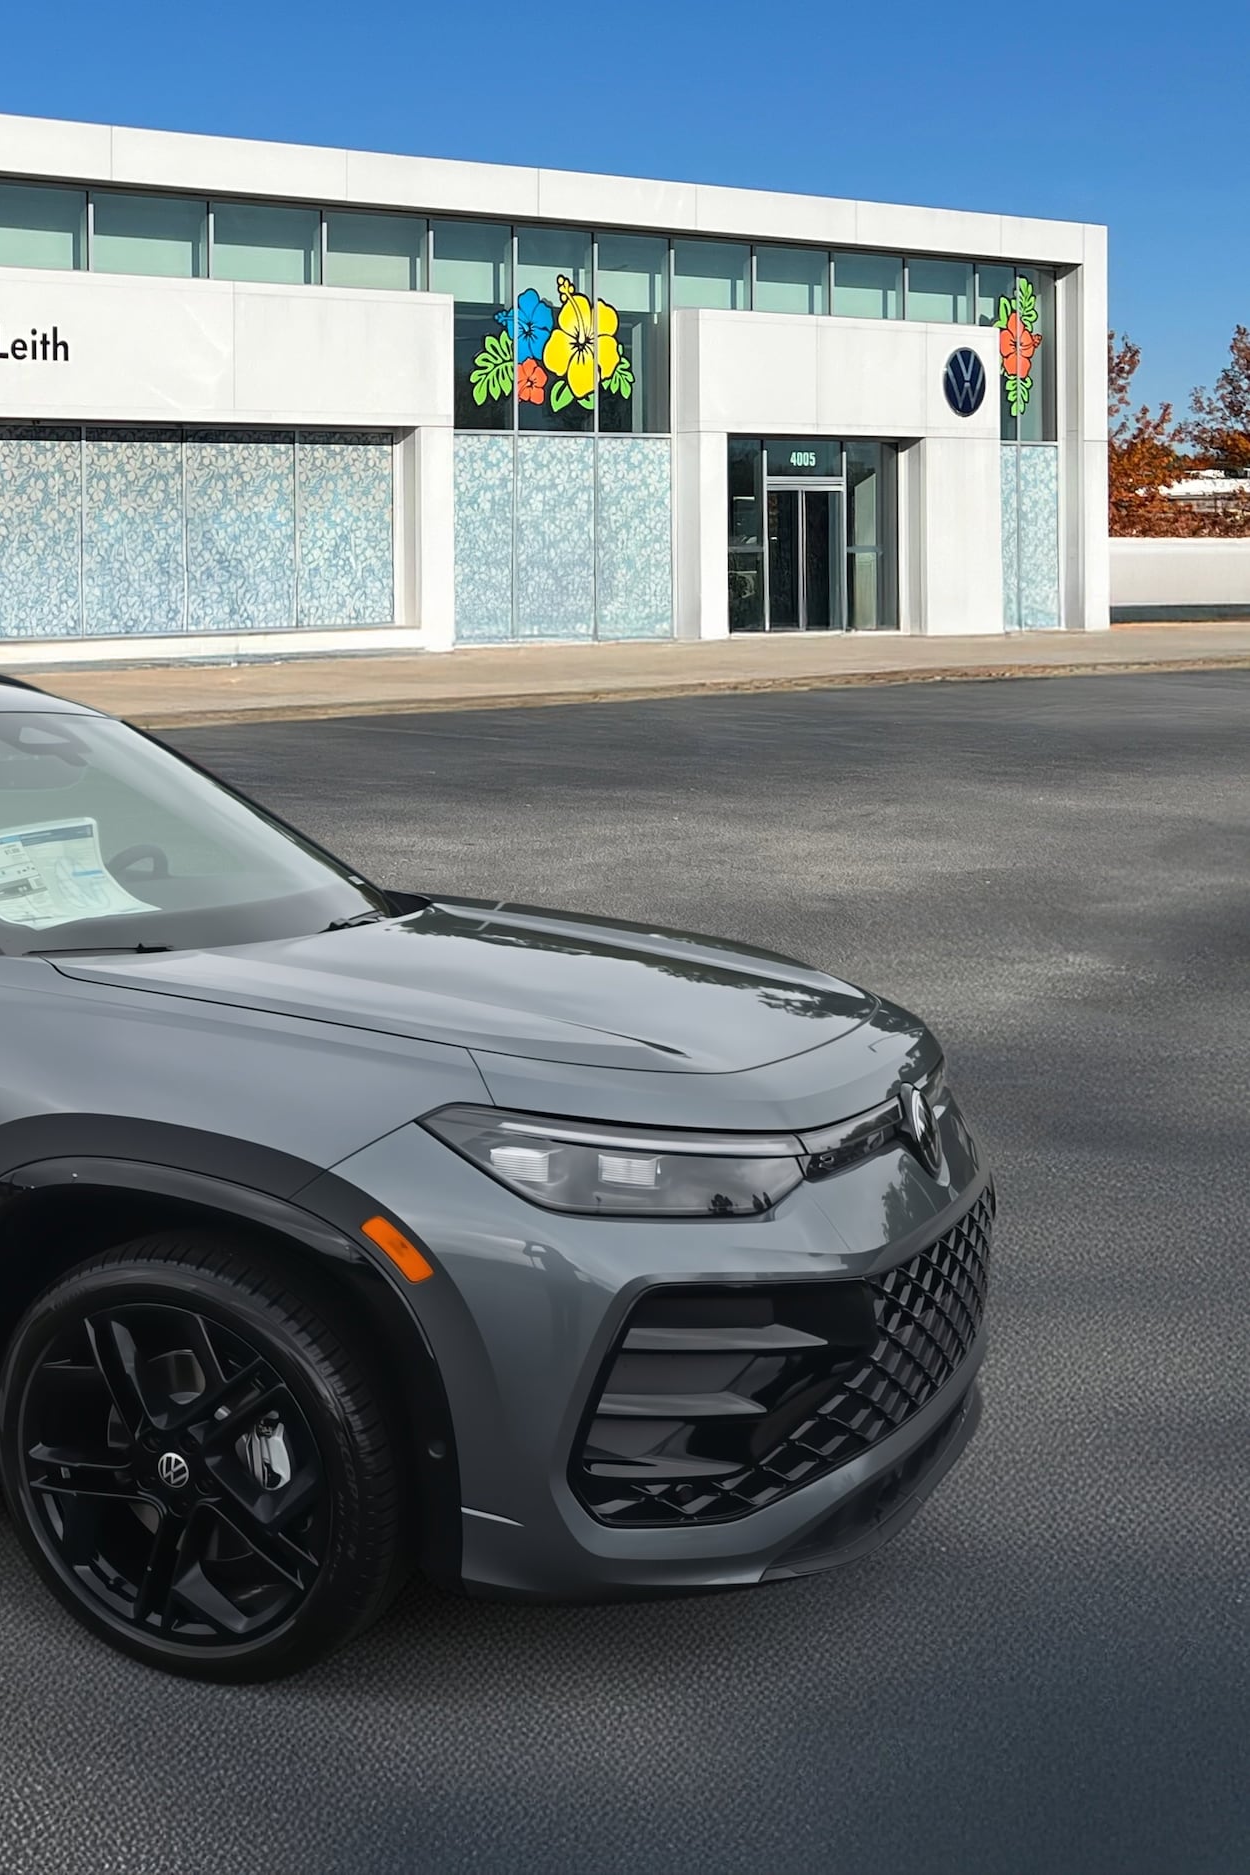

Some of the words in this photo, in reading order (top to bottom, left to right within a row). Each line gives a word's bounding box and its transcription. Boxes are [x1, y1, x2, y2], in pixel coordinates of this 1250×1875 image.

[945, 349, 985, 411] VW
[790, 451, 816, 466] 4005
[158, 1453, 189, 1487] VW
